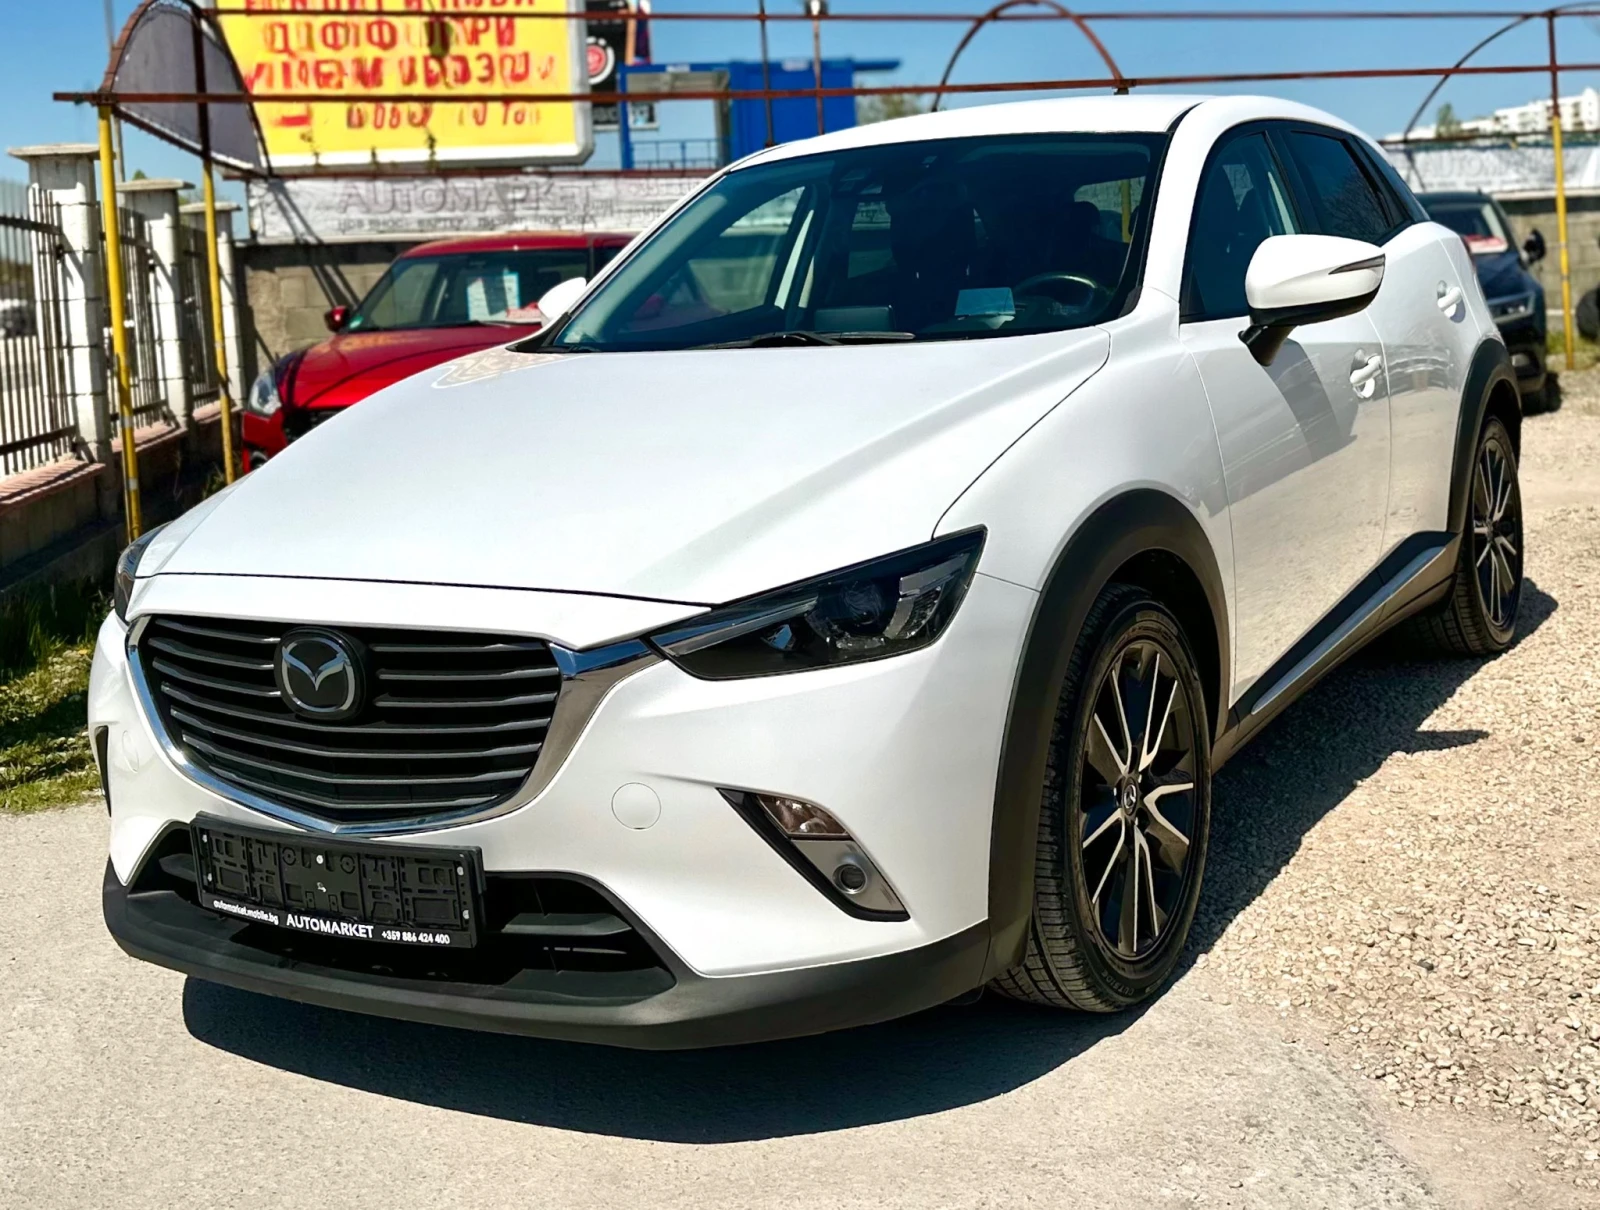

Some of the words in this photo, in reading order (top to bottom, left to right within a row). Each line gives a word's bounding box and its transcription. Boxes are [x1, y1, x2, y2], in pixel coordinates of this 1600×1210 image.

[337, 179, 596, 214] AUTOMARKET
[213, 900, 279, 925] automarket.mobile.bg
[286, 914, 374, 938] AUTOMARKET
[381, 931, 401, 941] +359
[402, 931, 418, 942] 886
[418, 933, 434, 943] 424
[435, 934, 451, 944] 400
